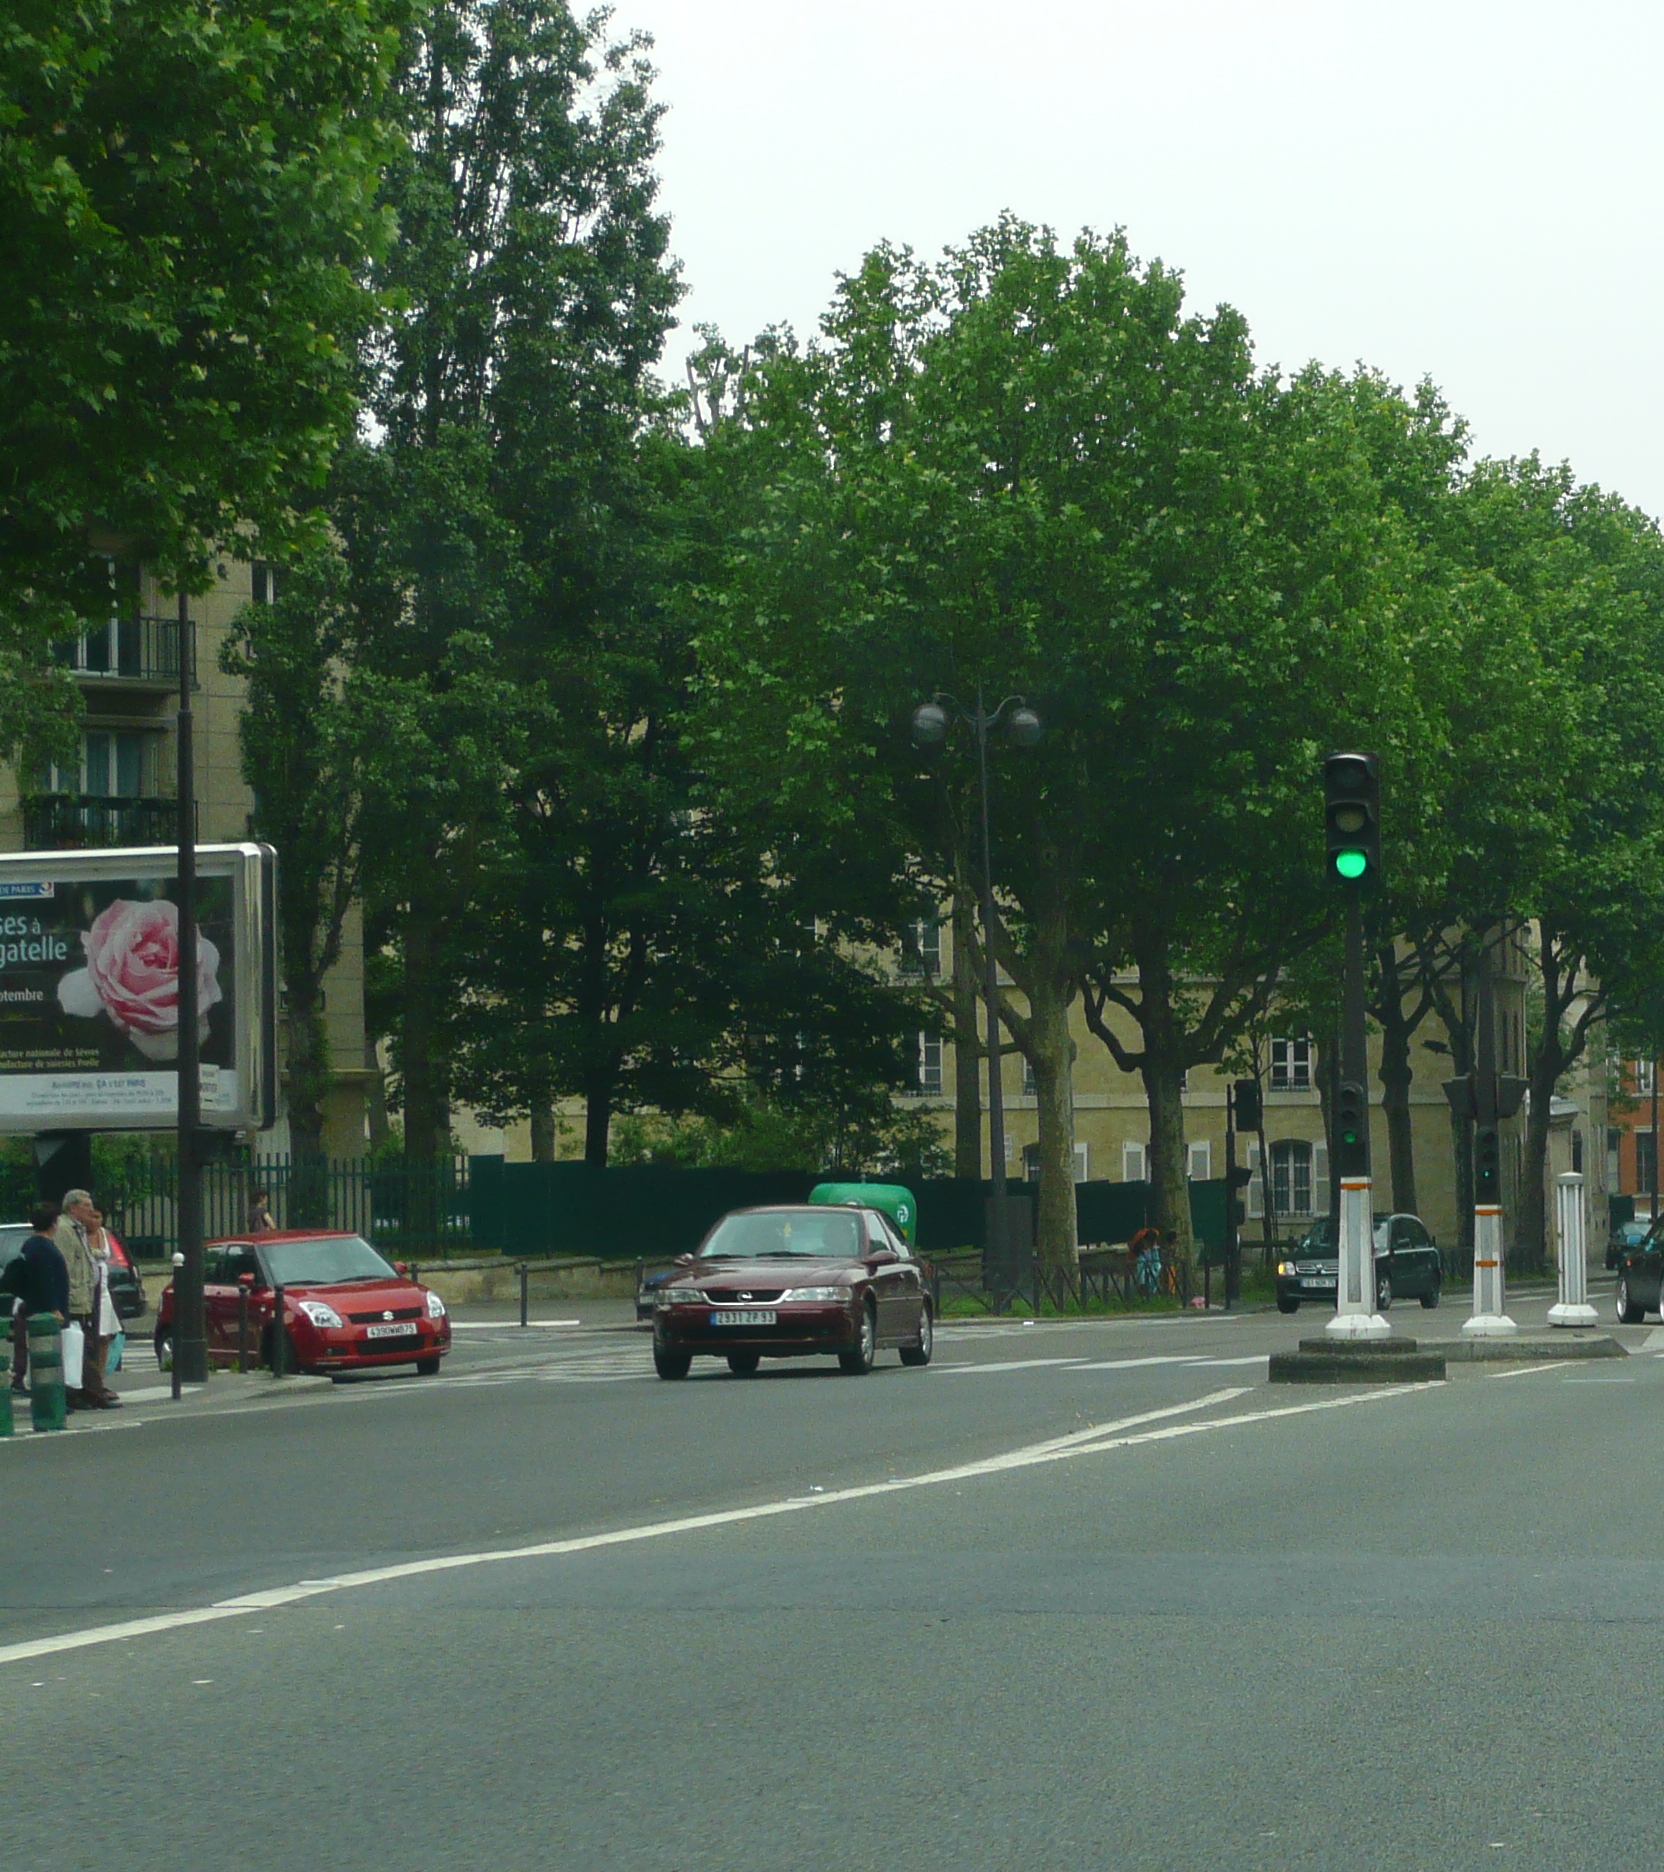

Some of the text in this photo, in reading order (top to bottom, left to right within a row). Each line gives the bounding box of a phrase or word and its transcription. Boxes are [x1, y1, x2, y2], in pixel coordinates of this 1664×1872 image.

[11, 885, 35, 894] PARIS
[718, 1312, 742, 1323] 2931
[761, 1311, 774, 1322] 93
